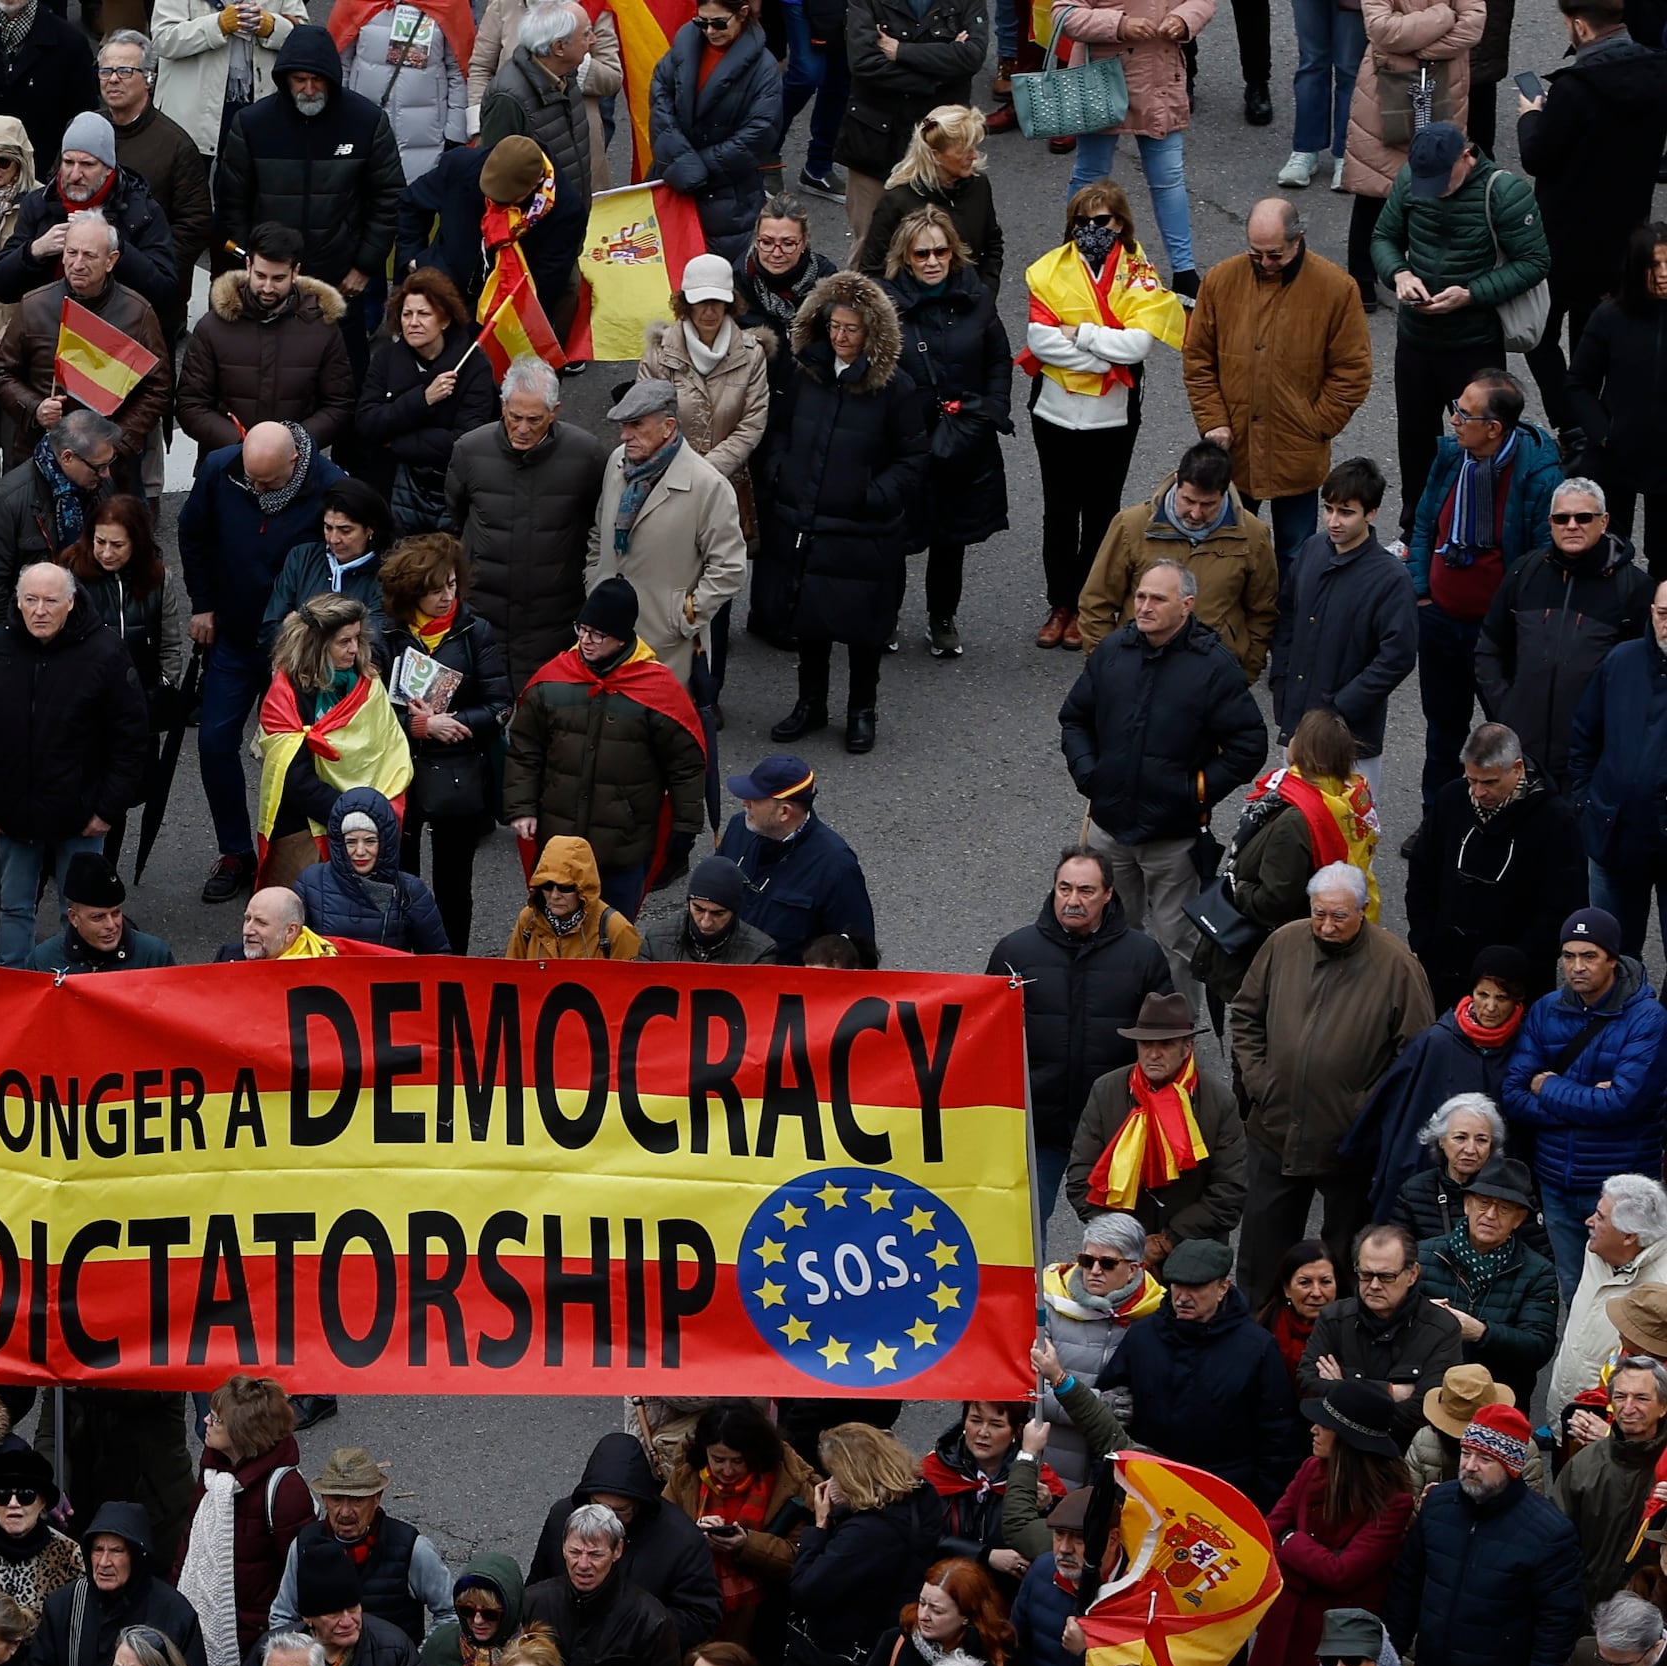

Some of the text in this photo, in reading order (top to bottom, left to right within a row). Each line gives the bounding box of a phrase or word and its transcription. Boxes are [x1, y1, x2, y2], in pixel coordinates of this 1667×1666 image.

[223, 1067, 268, 1149] A
[286, 980, 964, 1166] DEMOCRACY
[797, 1235, 921, 1305] S.O.S.
